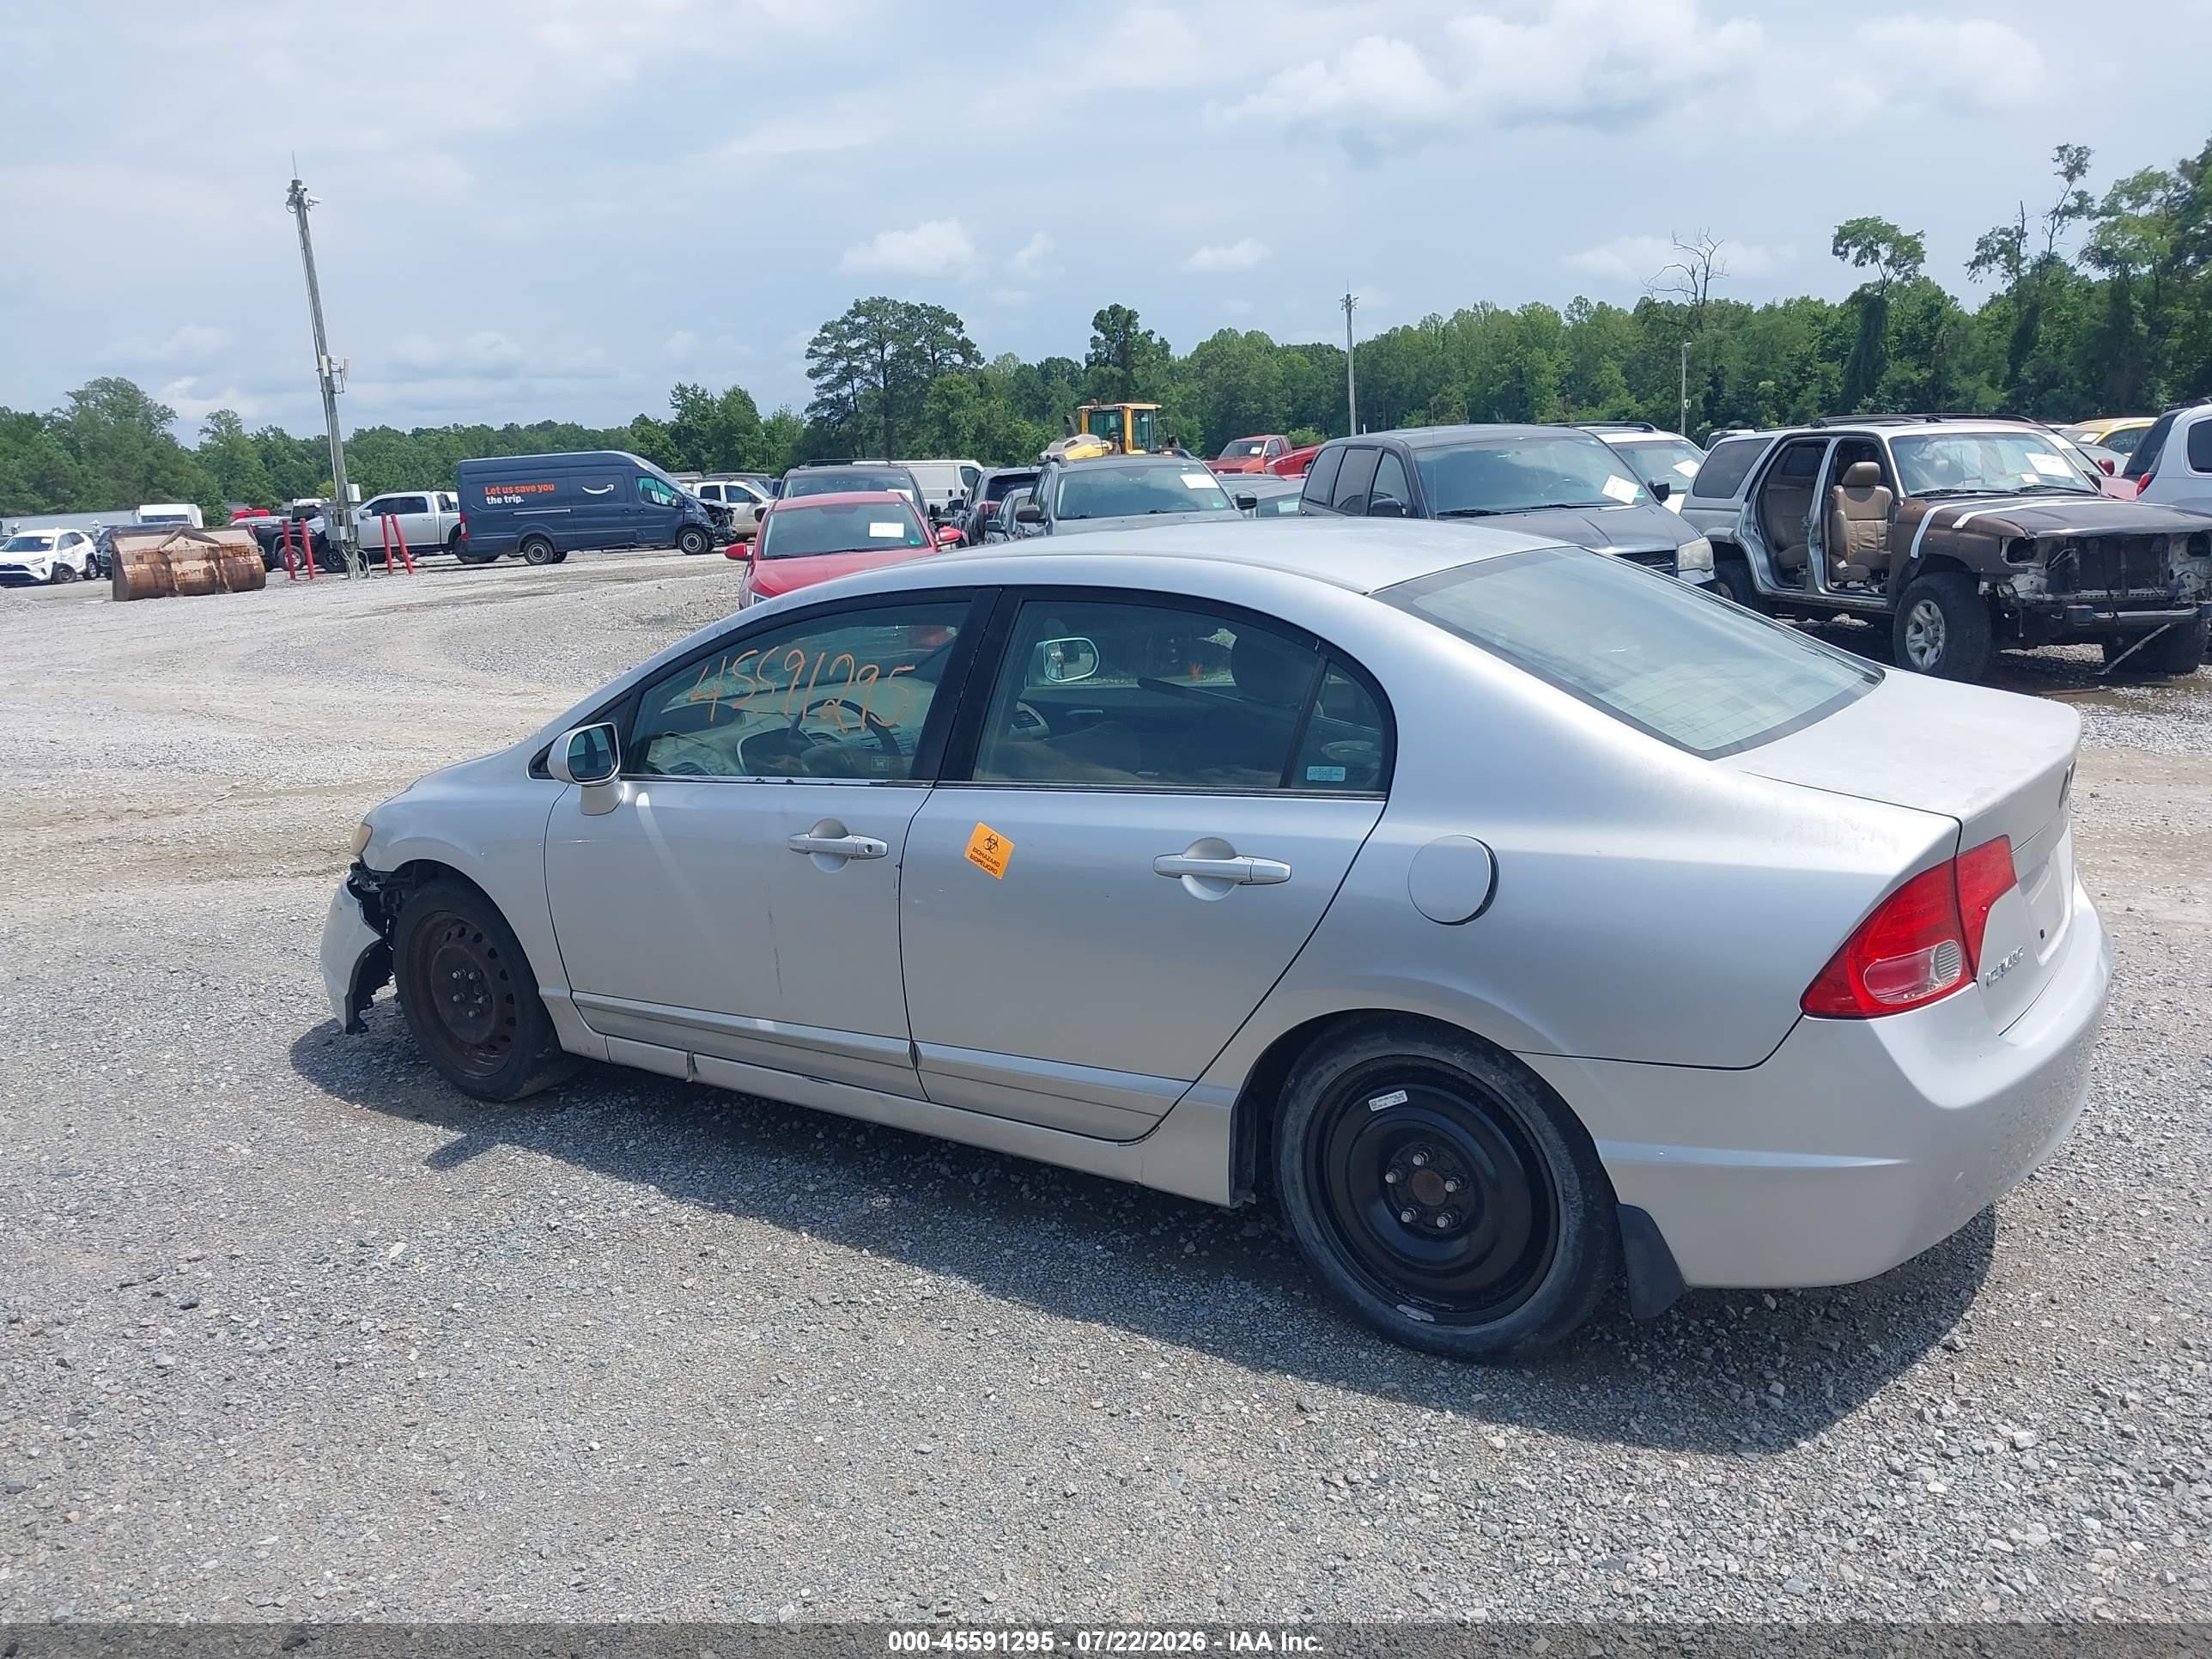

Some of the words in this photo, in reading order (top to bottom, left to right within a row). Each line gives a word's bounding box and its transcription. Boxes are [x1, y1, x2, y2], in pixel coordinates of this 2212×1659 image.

[484, 486, 501, 495] Let
[502, 486, 514, 495] us
[514, 484, 537, 494] save
[538, 483, 555, 493] you
[486, 495, 502, 505] the
[503, 494, 525, 504] trip.
[690, 646, 916, 734] 45591295
[972, 846, 1001, 867] BIOHAZARD
